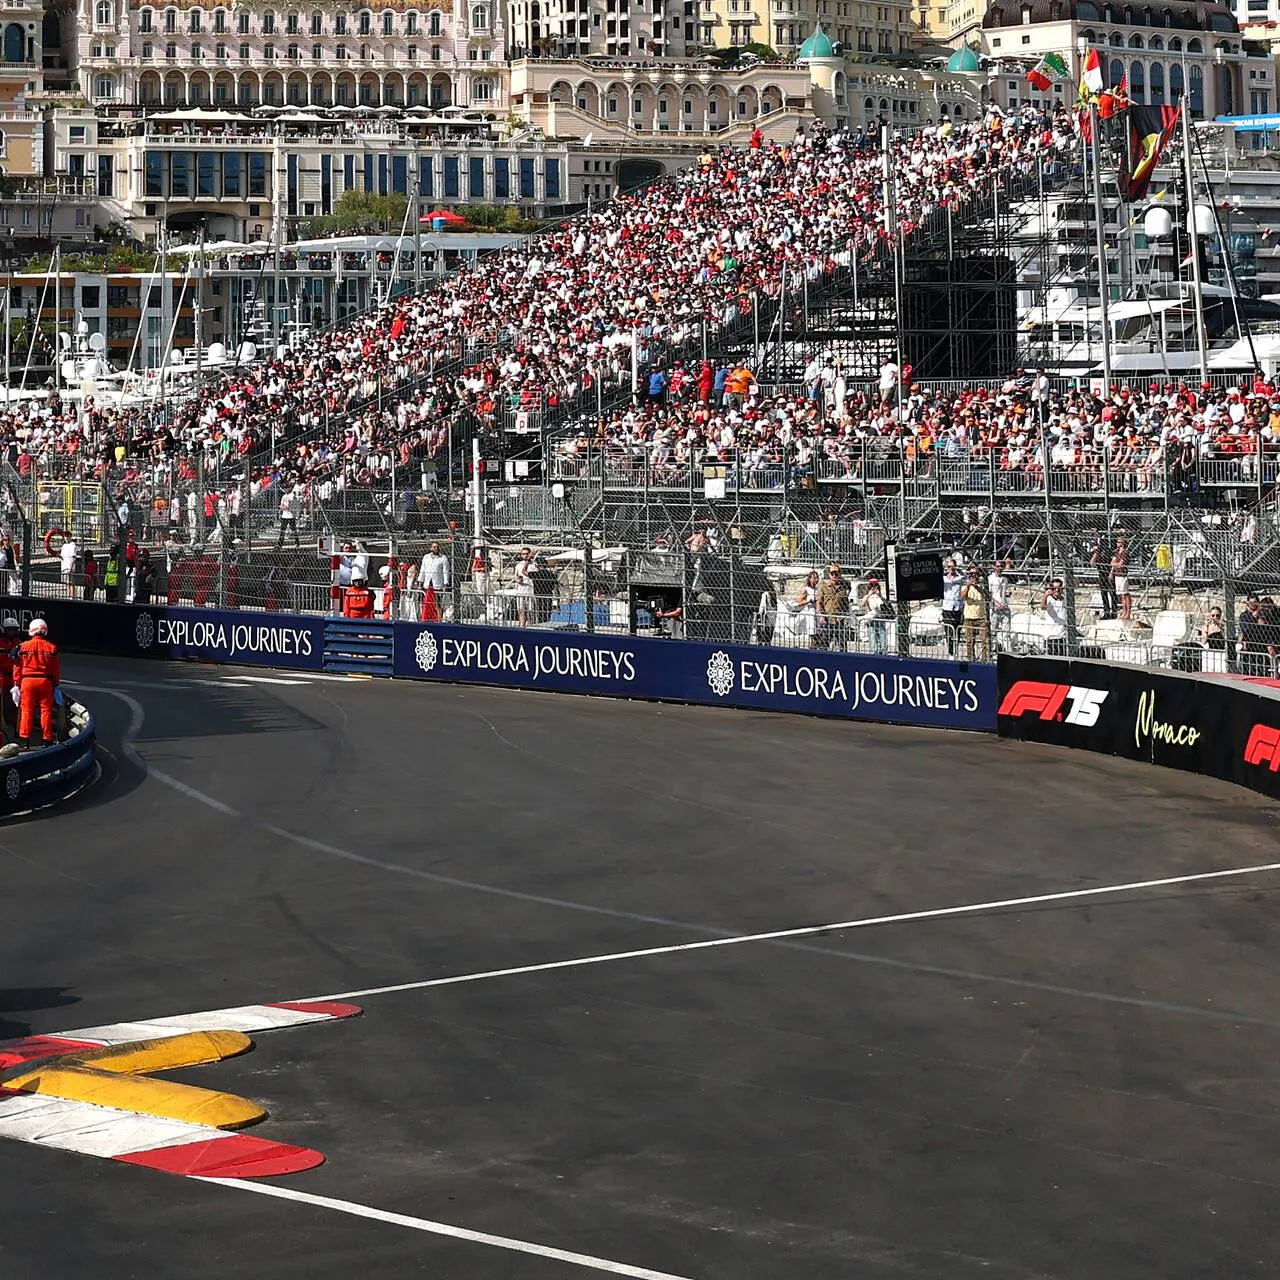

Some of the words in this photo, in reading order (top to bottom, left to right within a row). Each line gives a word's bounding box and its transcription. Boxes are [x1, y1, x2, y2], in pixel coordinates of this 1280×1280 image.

[158, 620, 228, 649] EXPLORA
[228, 624, 312, 656] JOURNEYS
[442, 639, 529, 672] EXPLORA
[532, 645, 635, 681] JOURNEYS
[741, 661, 848, 701] EXPLORA
[852, 671, 978, 712] JOURNEYS
[1065, 686, 1109, 727] 75
[1135, 689, 1201, 749] Monaco
